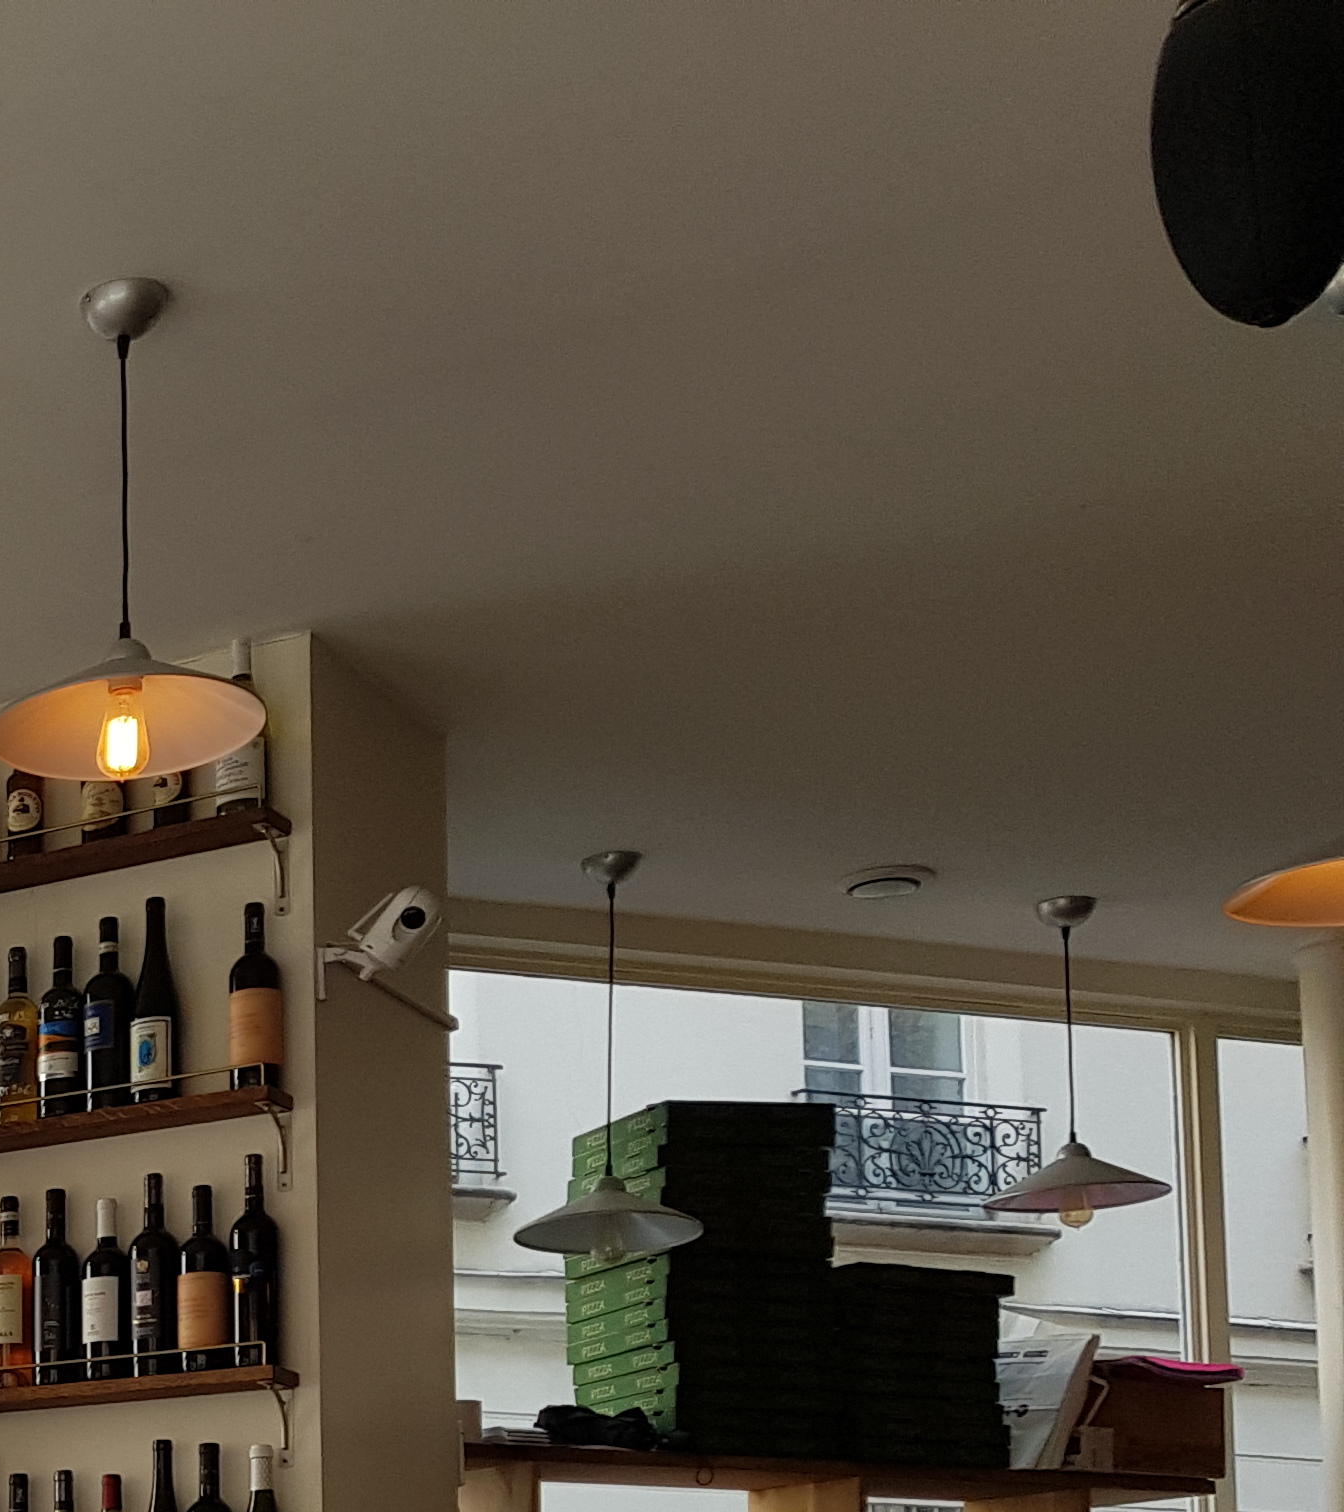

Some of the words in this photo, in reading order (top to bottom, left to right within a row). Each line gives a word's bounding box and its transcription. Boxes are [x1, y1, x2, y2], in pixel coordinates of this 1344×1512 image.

[581, 1281, 605, 1296] PIZZA
[624, 1287, 650, 1302] PIZZA
[581, 1300, 604, 1316] PIZZA
[582, 1322, 604, 1337] PIZZA
[626, 1330, 651, 1346] PIZZA
[582, 1343, 606, 1358] PIZZA
[632, 1353, 658, 1367] PIZZA
[588, 1364, 612, 1379] PIZZA
[636, 1375, 662, 1389] PIZZA
[591, 1385, 615, 1399] PIZZA
